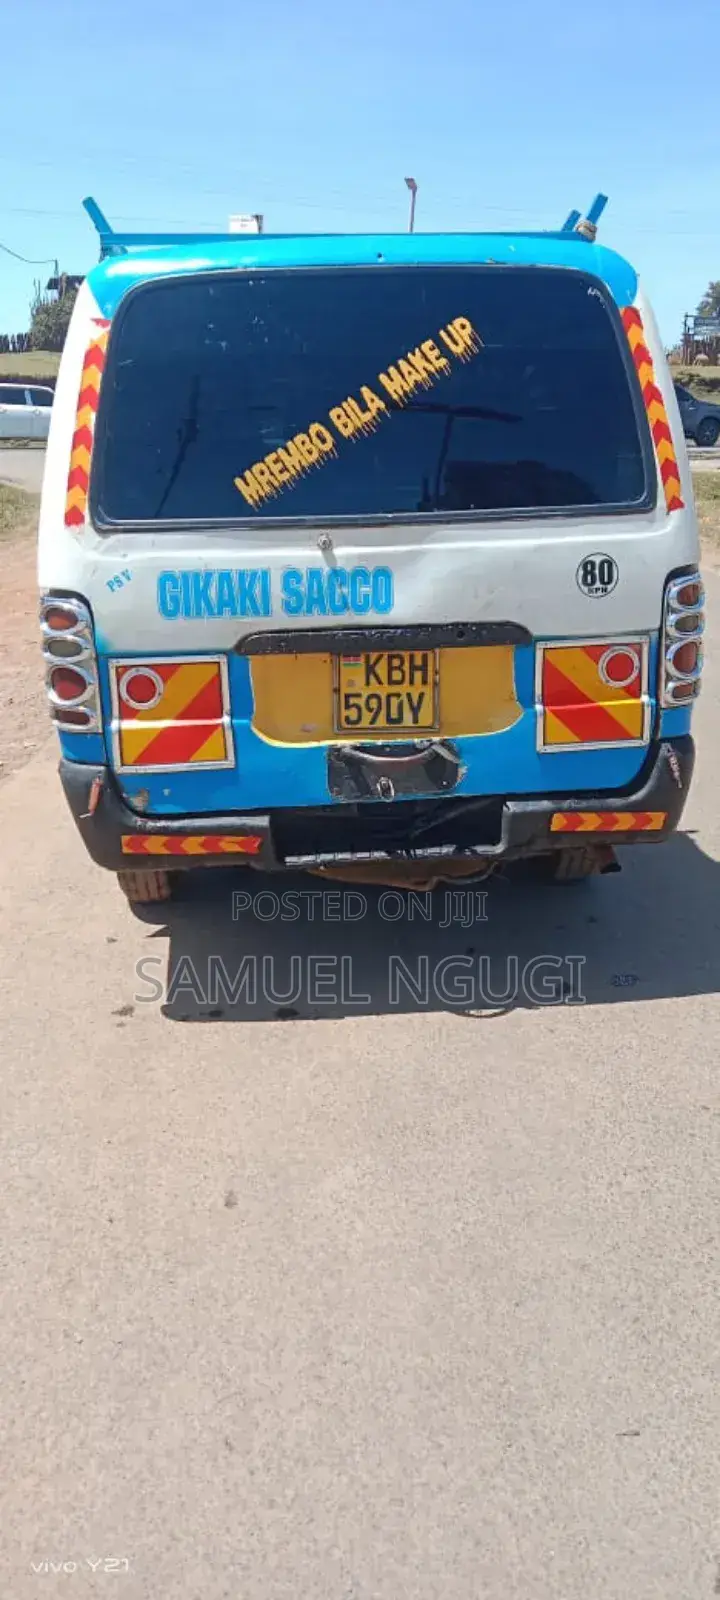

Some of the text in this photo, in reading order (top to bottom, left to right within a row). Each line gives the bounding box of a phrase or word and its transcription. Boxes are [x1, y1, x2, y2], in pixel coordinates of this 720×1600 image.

[234, 316, 485, 512] MREMBO BILA MAKE UP
[582, 558, 614, 587] 80
[157, 566, 394, 620] GIKAKI SACCO
[364, 652, 429, 687] KBH
[344, 692, 425, 725] 590Y
